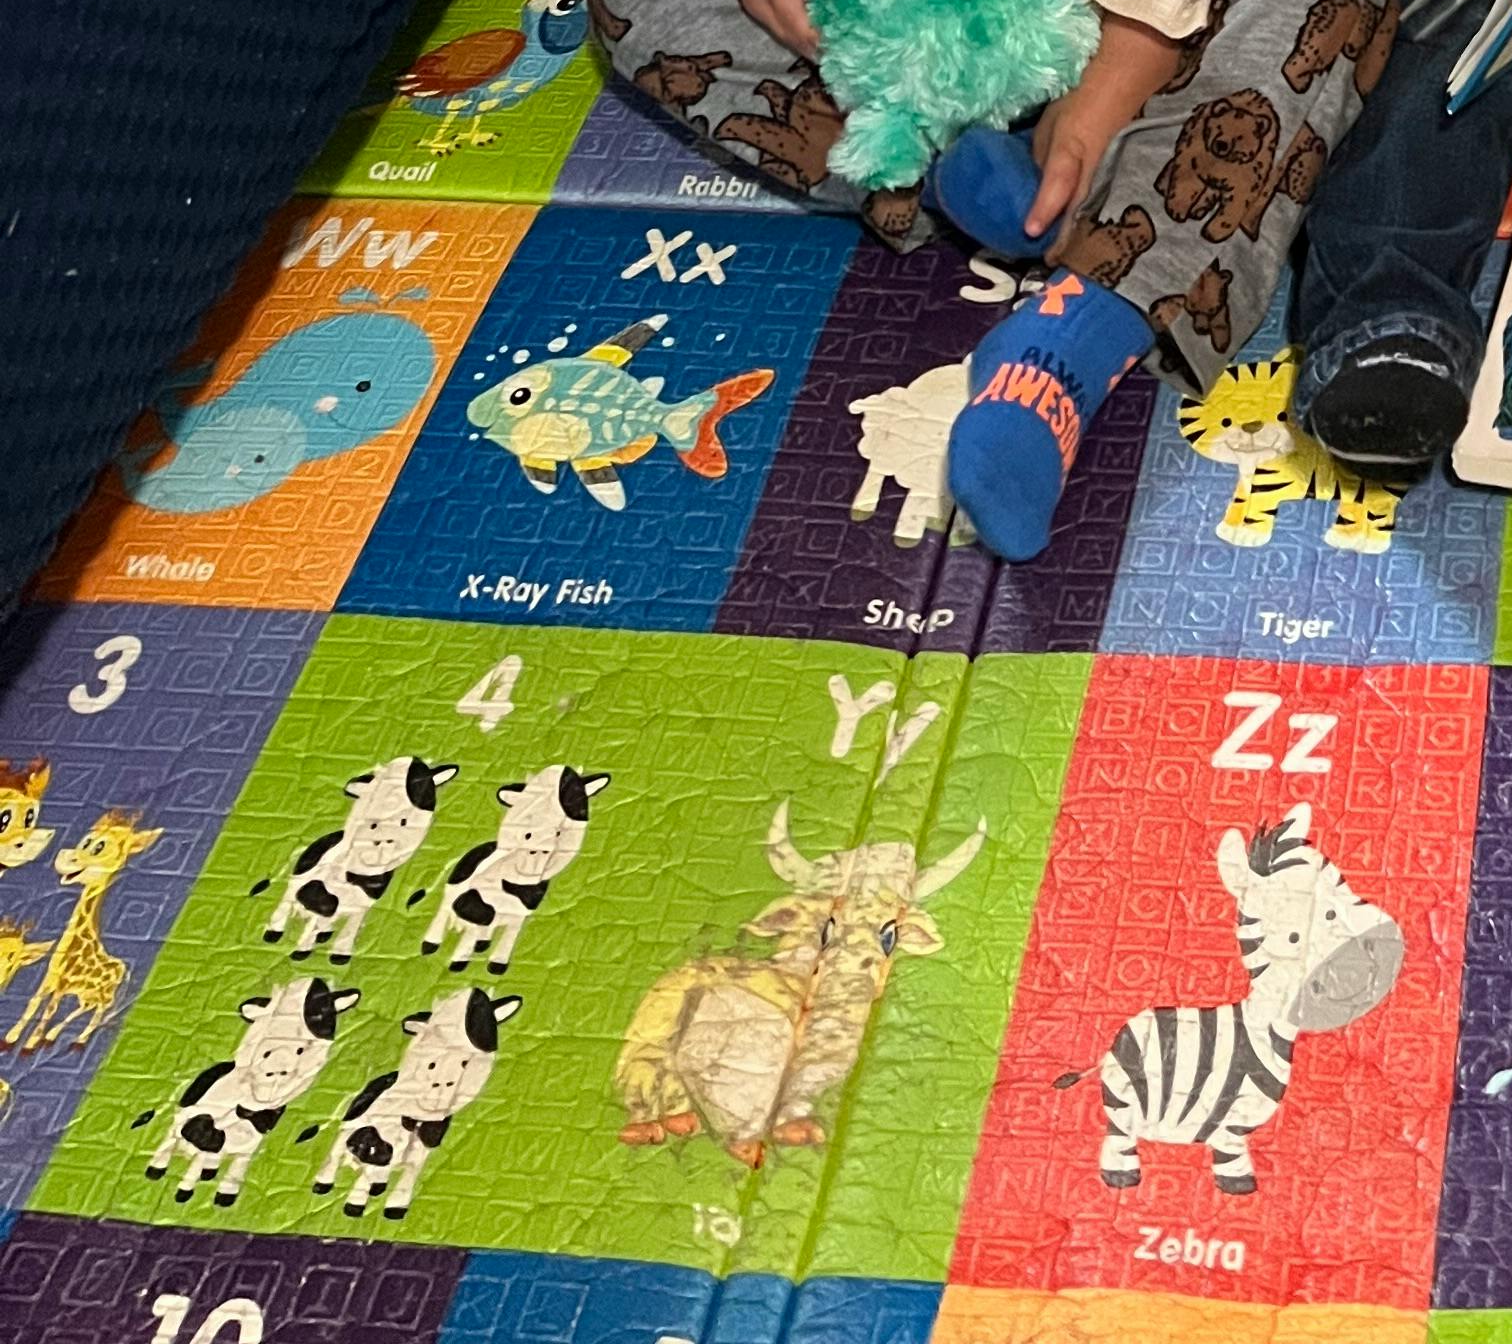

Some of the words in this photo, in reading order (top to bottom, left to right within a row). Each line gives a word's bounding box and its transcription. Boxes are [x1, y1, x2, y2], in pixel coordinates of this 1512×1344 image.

[368, 160, 437, 185] Quail
[620, 227, 737, 285] Xx
[125, 555, 217, 582] Whale
[459, 574, 550, 612] X-Ray
[555, 578, 613, 607] Fish
[862, 598, 955, 634] Shep
[1259, 611, 1334, 645] Tiger
[67, 635, 143, 714] 3
[455, 653, 524, 732] 4
[1210, 691, 1340, 774] Zz
[1133, 1225, 1246, 1272] Zebra
[150, 1293, 264, 1344] 10
